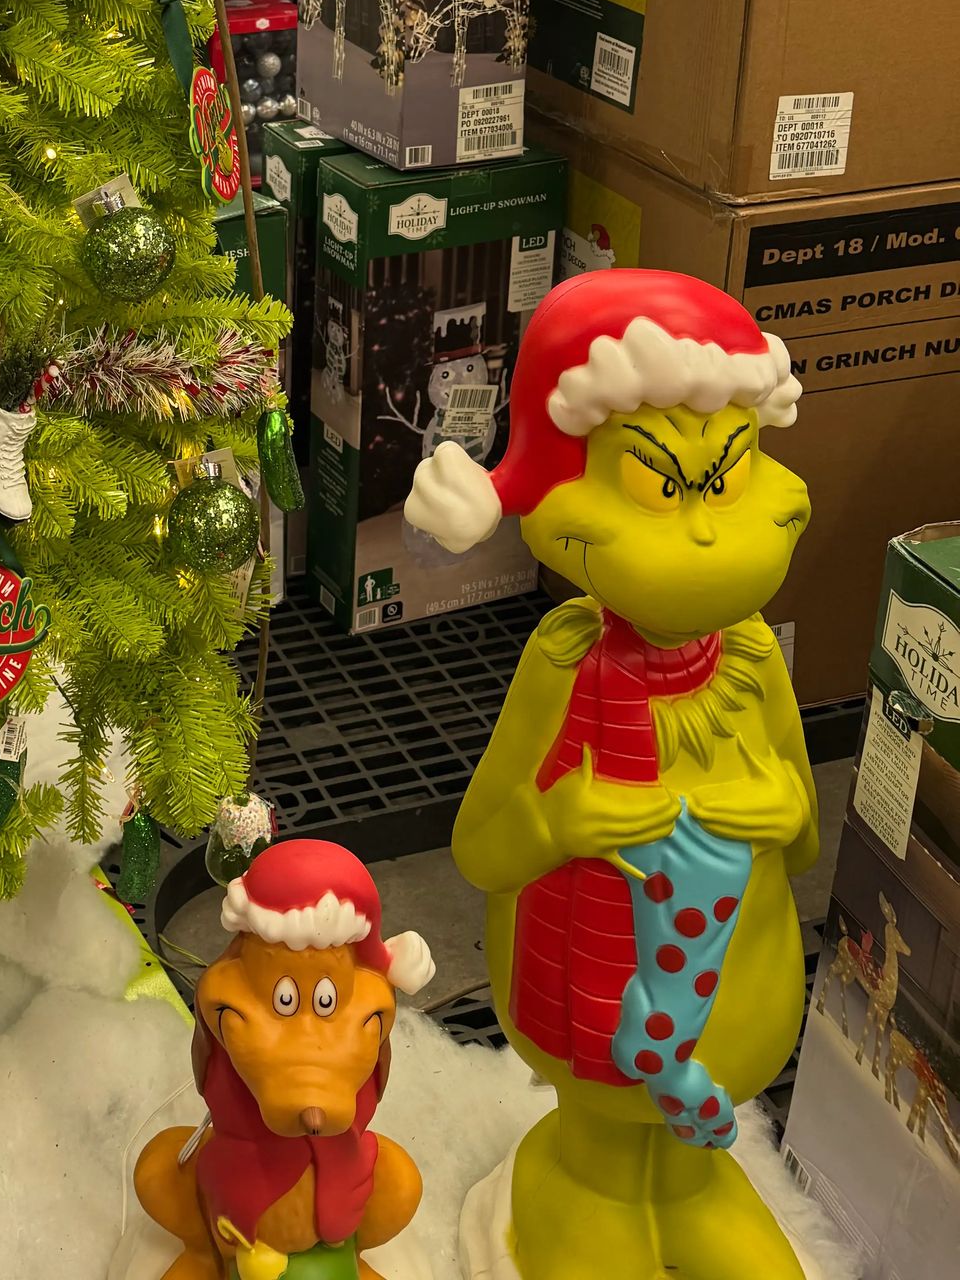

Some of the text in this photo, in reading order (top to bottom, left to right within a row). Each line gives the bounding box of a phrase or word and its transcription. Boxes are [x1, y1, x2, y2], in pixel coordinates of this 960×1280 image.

[461, 120, 471, 128] PO
[462, 108, 500, 119] DEPT 00018
[778, 122, 824, 132] DEPT 00018
[776, 144, 794, 152] ITEM
[450, 194, 546, 216] LIGHT-UP SNOWMAN
[328, 212, 352, 235] HOLIDAY
[396, 216, 438, 229] HOLIDAY
[324, 236, 354, 260] LIGHT-UP
[522, 236, 544, 248] LED
[762, 242, 824, 265] Dept
[834, 238, 864, 256] 18
[870, 235, 880, 252] /
[886, 228, 945, 250] Mod.
[323, 244, 355, 271] SNOWMAN
[755, 298, 832, 322] CMAS
[840, 284, 932, 311] PORCH
[816, 344, 916, 372] GRINCH
[895, 634, 959, 707] HOLIDA
[912, 668, 948, 711] TIME
[886, 703, 908, 734] LED
[874, 753, 888, 770] WITH
[880, 746, 891, 758] LED
[892, 758, 910, 780] LIGHTS
[894, 753, 908, 771] WITH
[905, 745, 916, 758] AND
[867, 752, 909, 800] LISTED ADAPTOR
[876, 776, 882, 786] TO
[862, 774, 906, 826] COLLAPSIBLE FOR
[865, 800, 894, 834] LIGHTS ARE
[877, 800, 900, 828] STORAGE
[860, 808, 897, 849] TO THE FRAME
